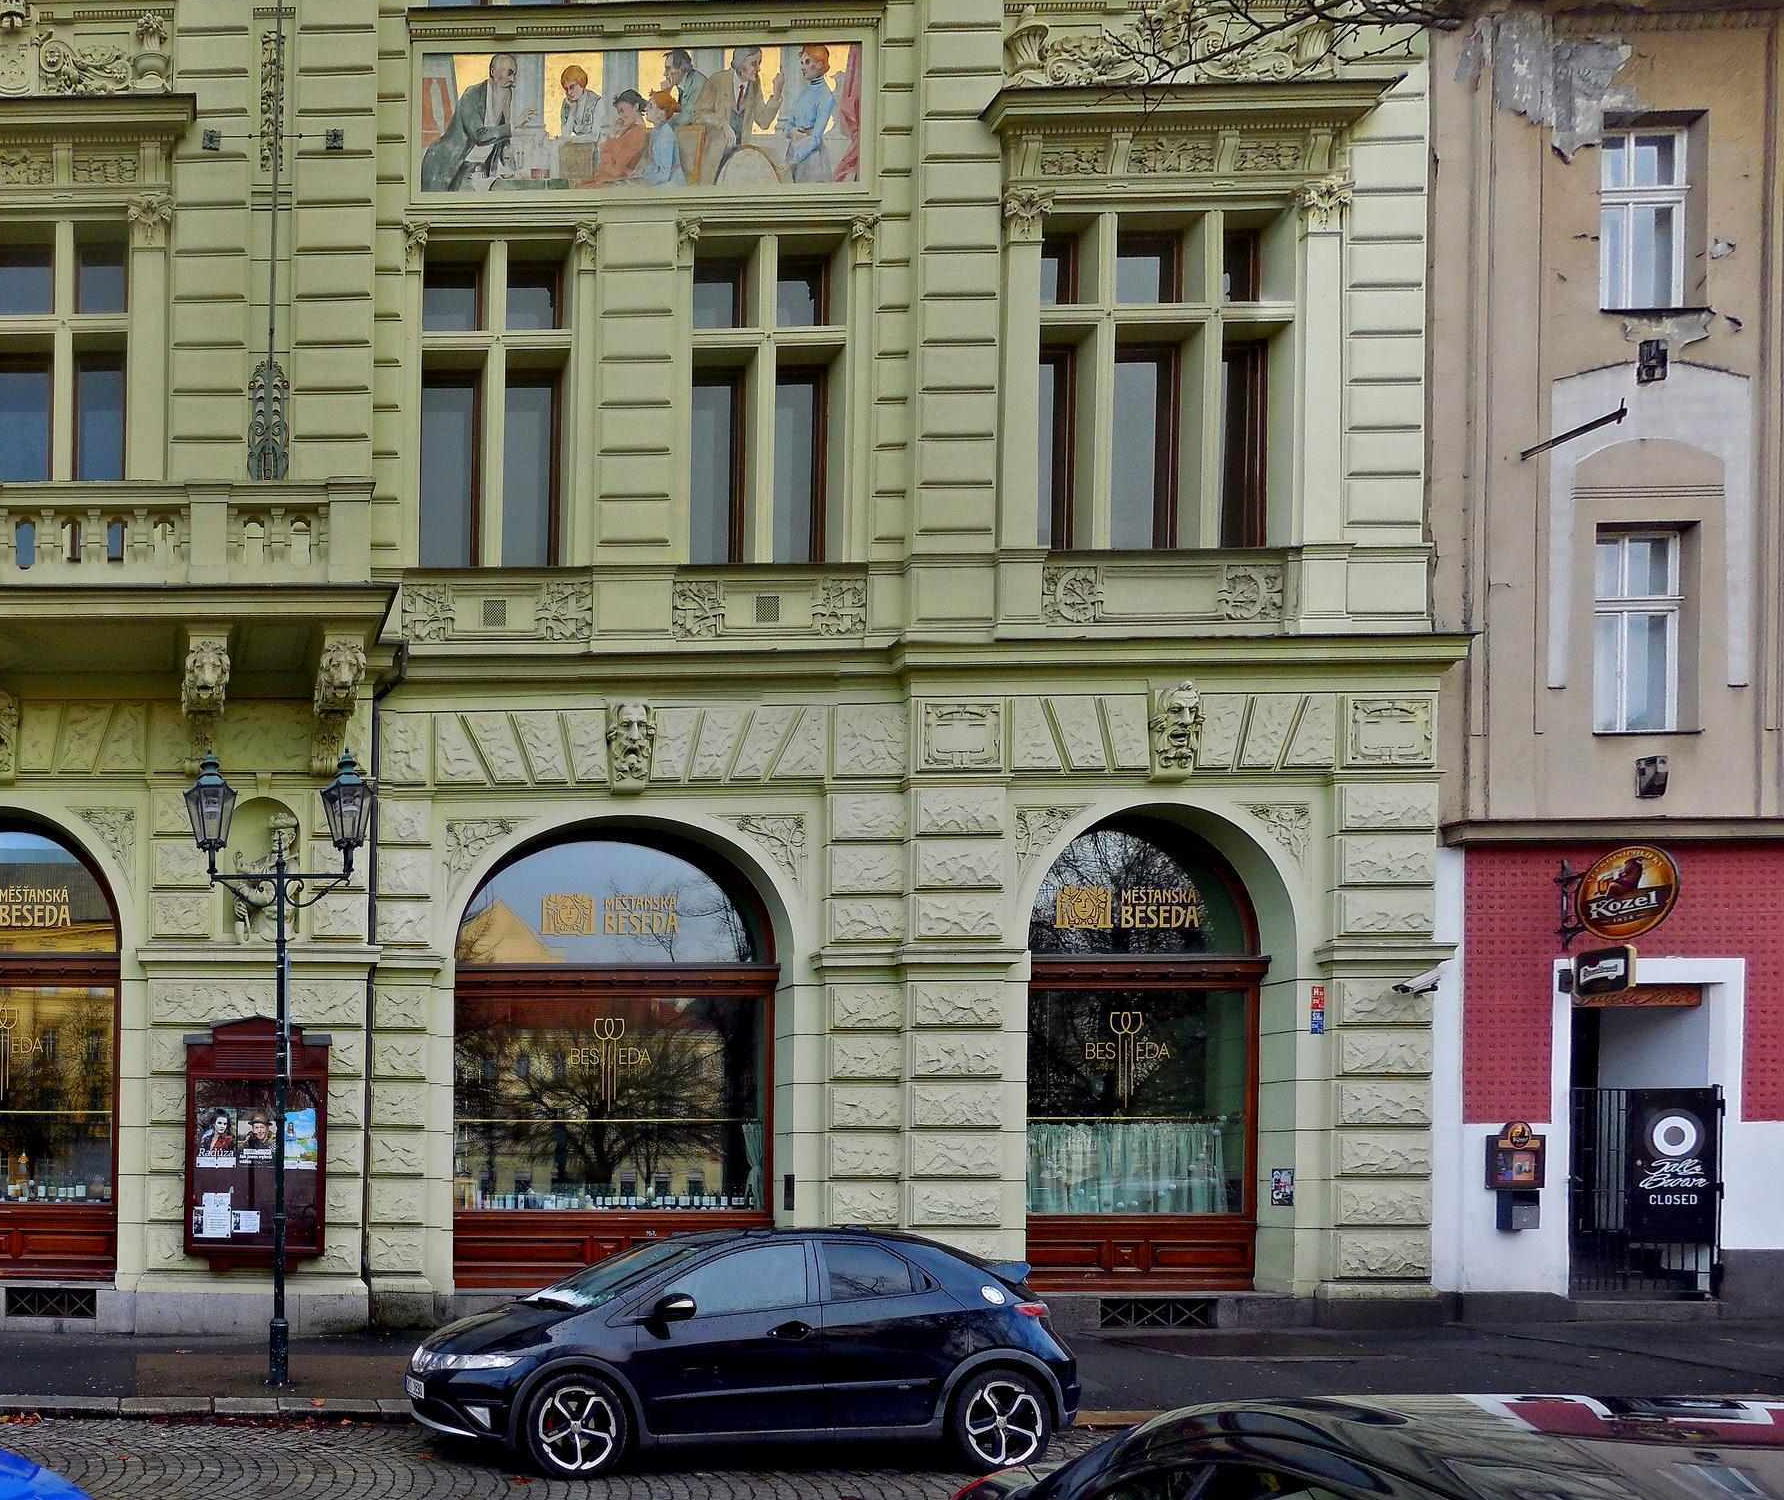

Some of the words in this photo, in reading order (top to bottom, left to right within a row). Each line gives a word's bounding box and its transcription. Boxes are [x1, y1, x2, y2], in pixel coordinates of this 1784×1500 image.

[0, 885, 69, 902] MĚŠŤANSKÁ
[1121, 885, 1197, 904] MĚŠŤANSKÁ
[1589, 890, 1658, 920] Kozel
[604, 912, 679, 935] BESEDA
[1121, 905, 1199, 928] BESEDA
[1649, 1194, 1698, 1205] CLOSED
